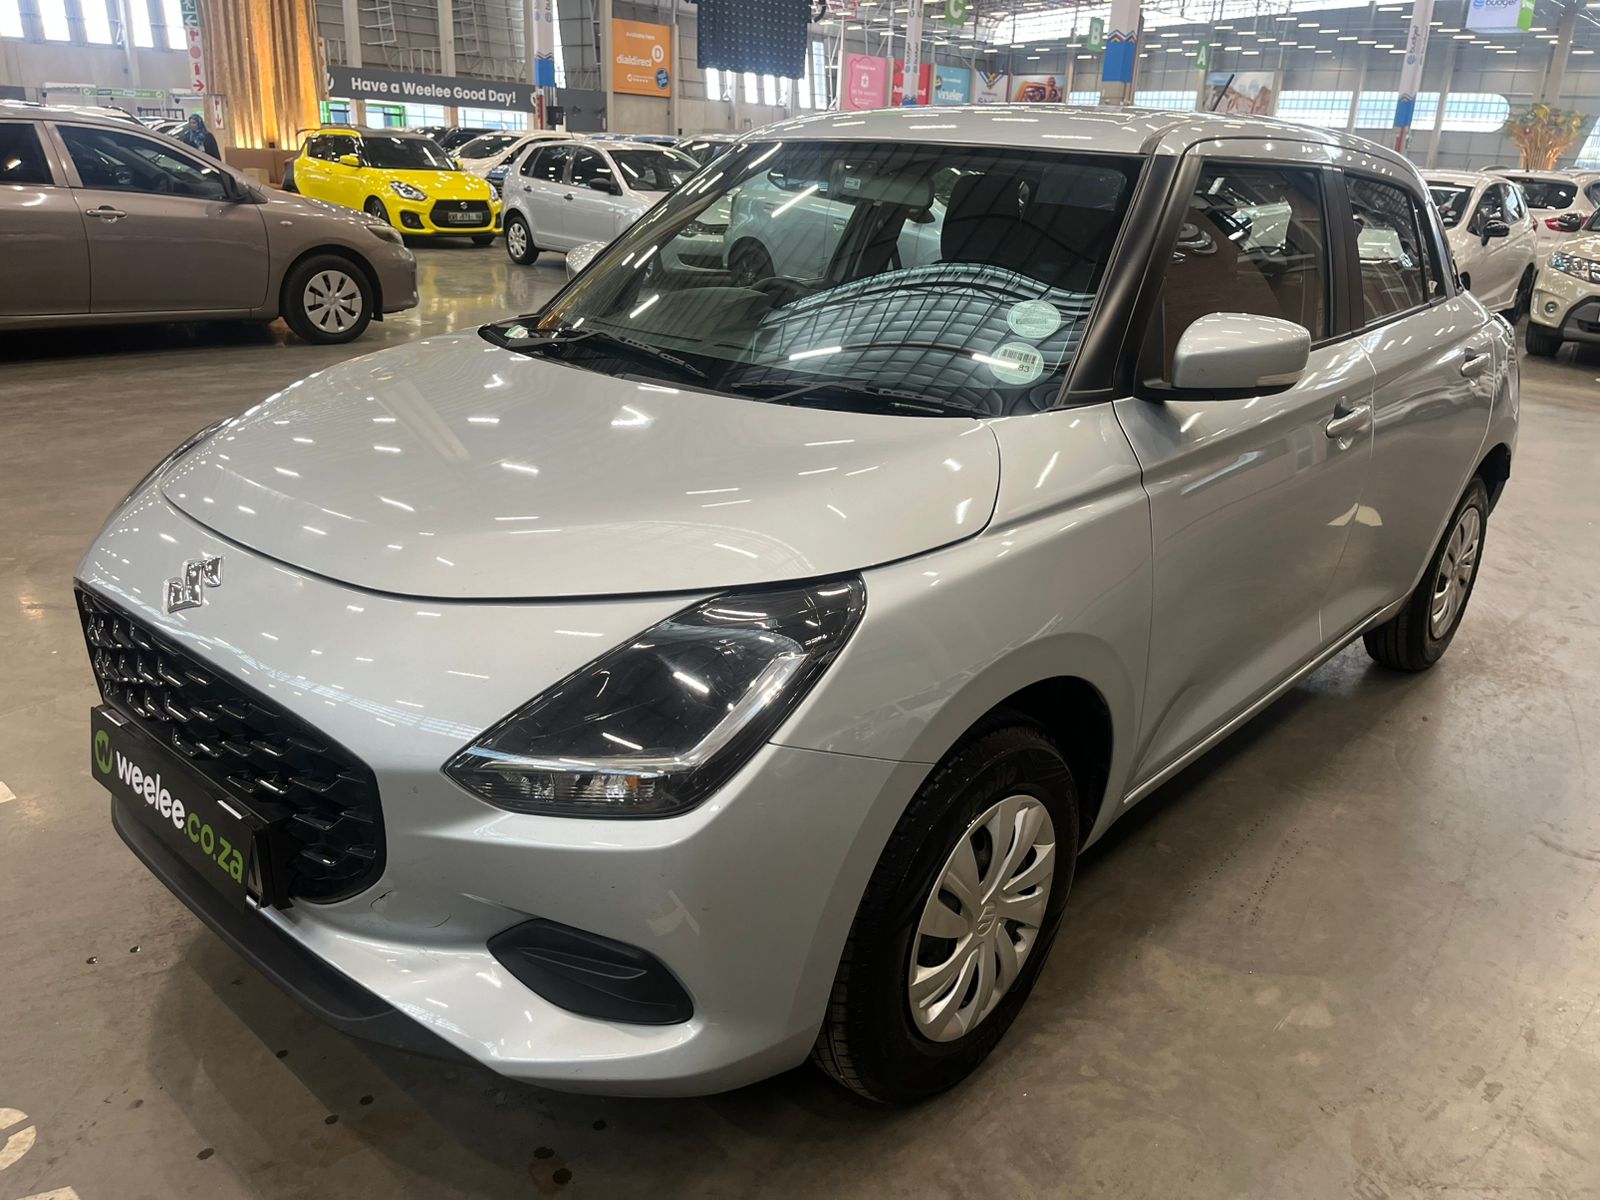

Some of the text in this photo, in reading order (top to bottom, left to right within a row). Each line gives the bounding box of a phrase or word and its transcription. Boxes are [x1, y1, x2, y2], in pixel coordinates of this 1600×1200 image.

[949, 0, 964, 19] C
[1091, 21, 1104, 45] B
[1197, 45, 1206, 65] A
[351, 76, 516, 106] Have a Weelee Good Day!
[116, 750, 244, 884] weelee.co.za
